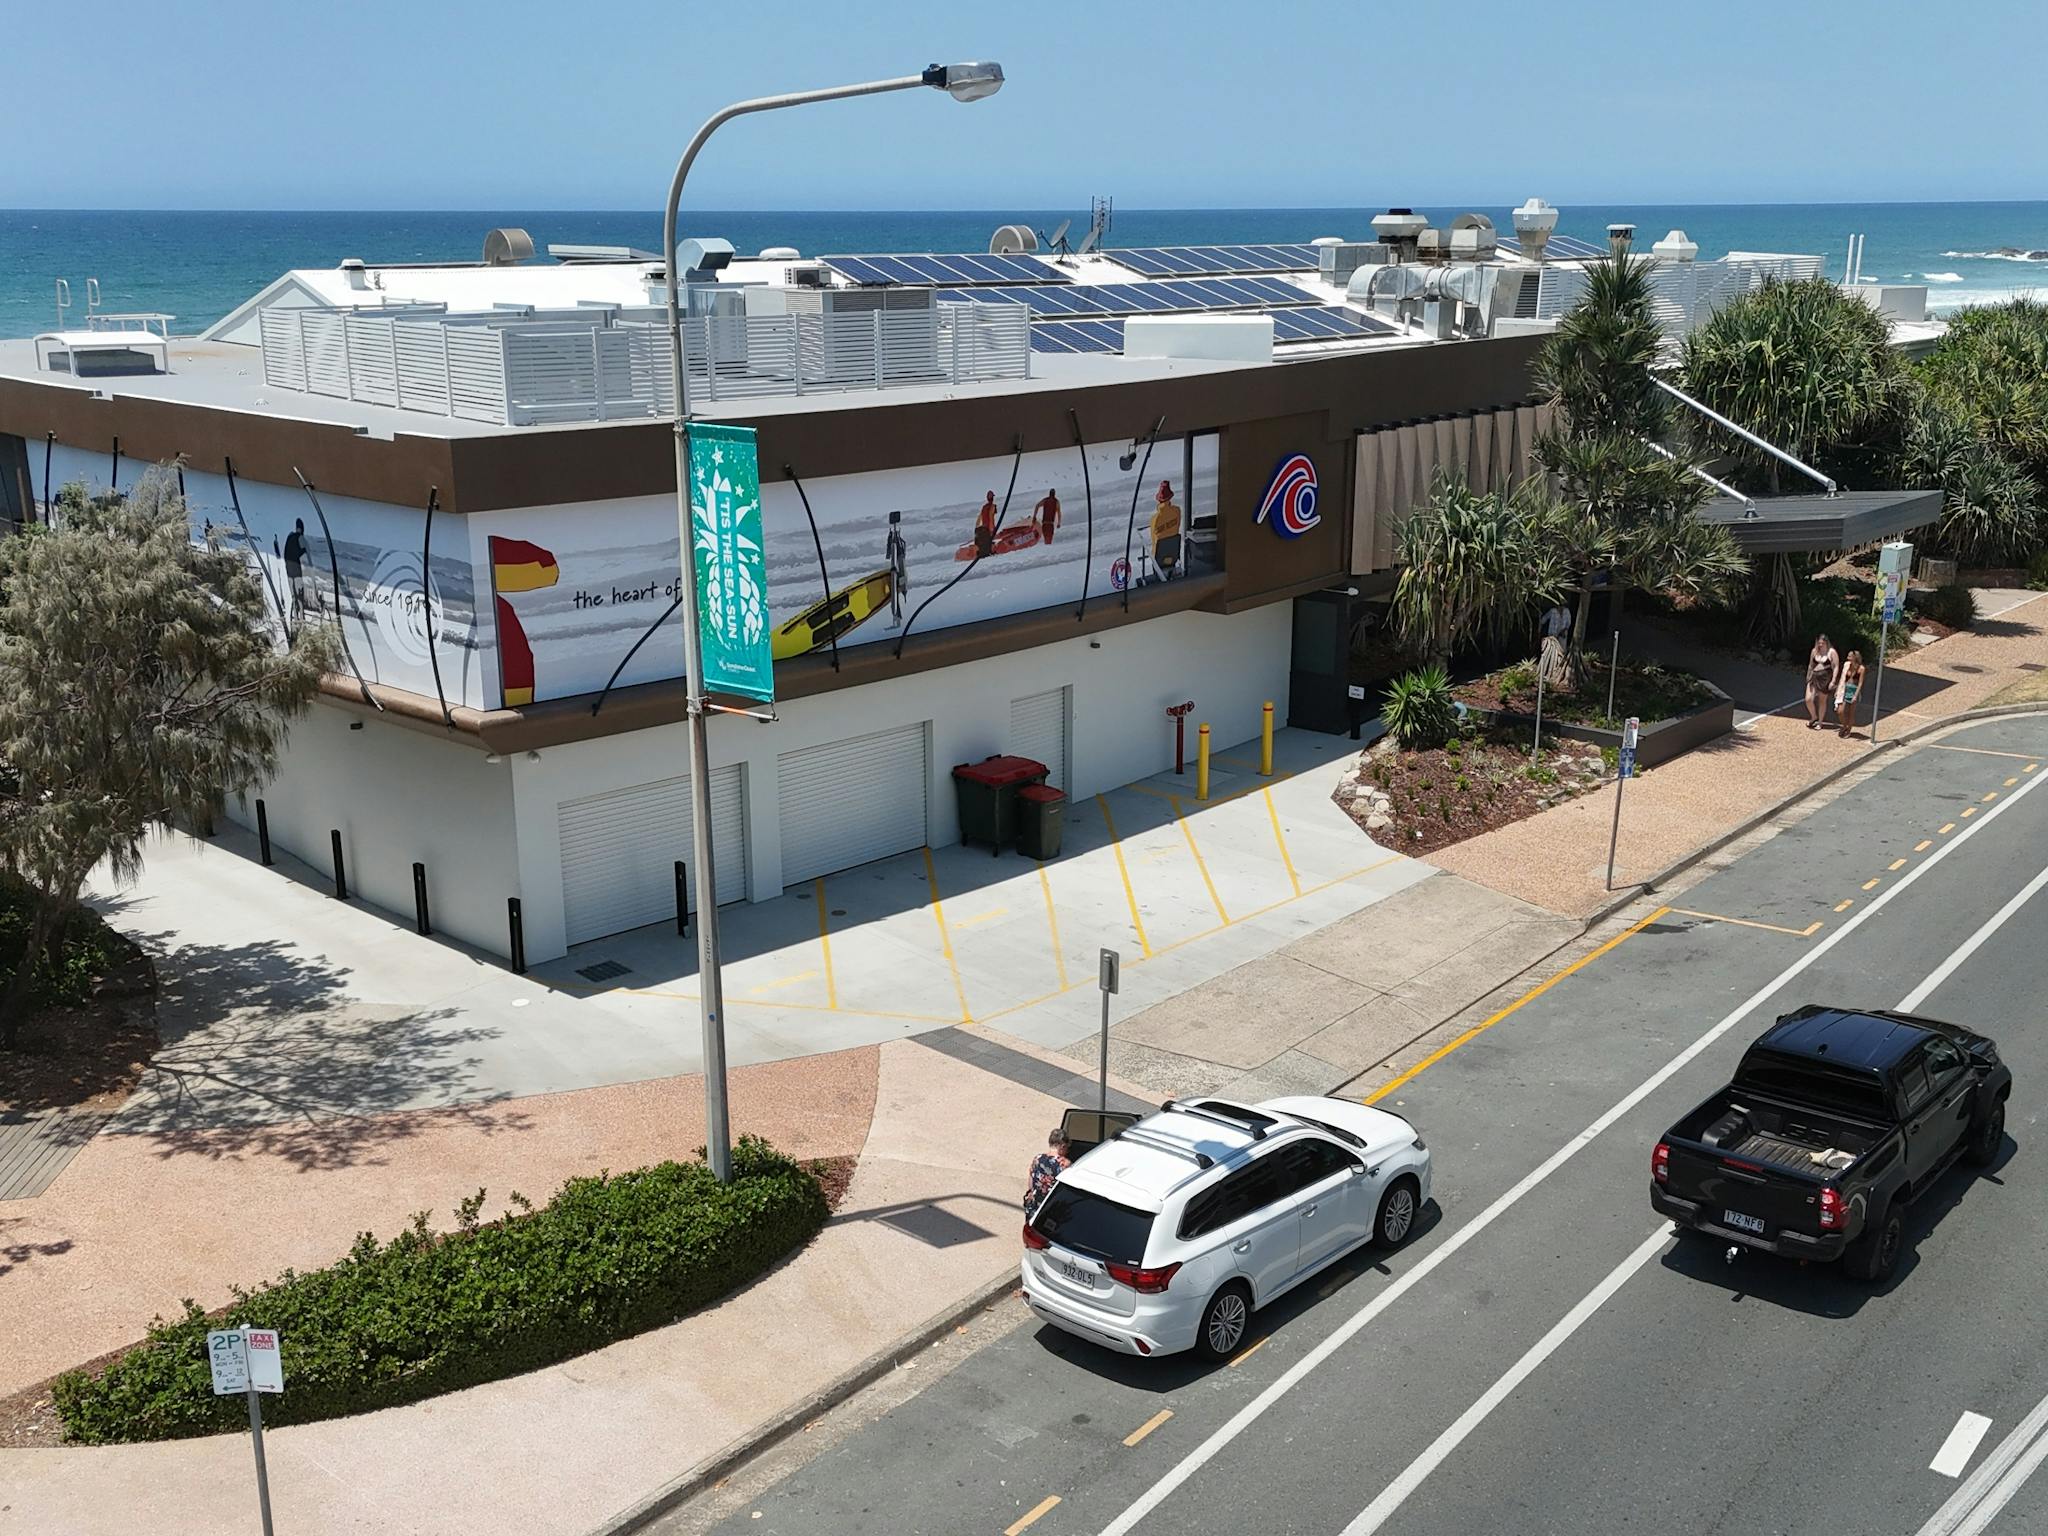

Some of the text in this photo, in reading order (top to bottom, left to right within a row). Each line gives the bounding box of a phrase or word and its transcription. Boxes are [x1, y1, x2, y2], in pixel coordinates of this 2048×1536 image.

[721, 532, 732, 565] THE
[573, 577, 682, 609] the heart of
[723, 567, 738, 639] SEA-SUN
[212, 1334, 241, 1350] 2P
[251, 1334, 273, 1342] TAXI
[251, 1341, 273, 1349] ZONE
